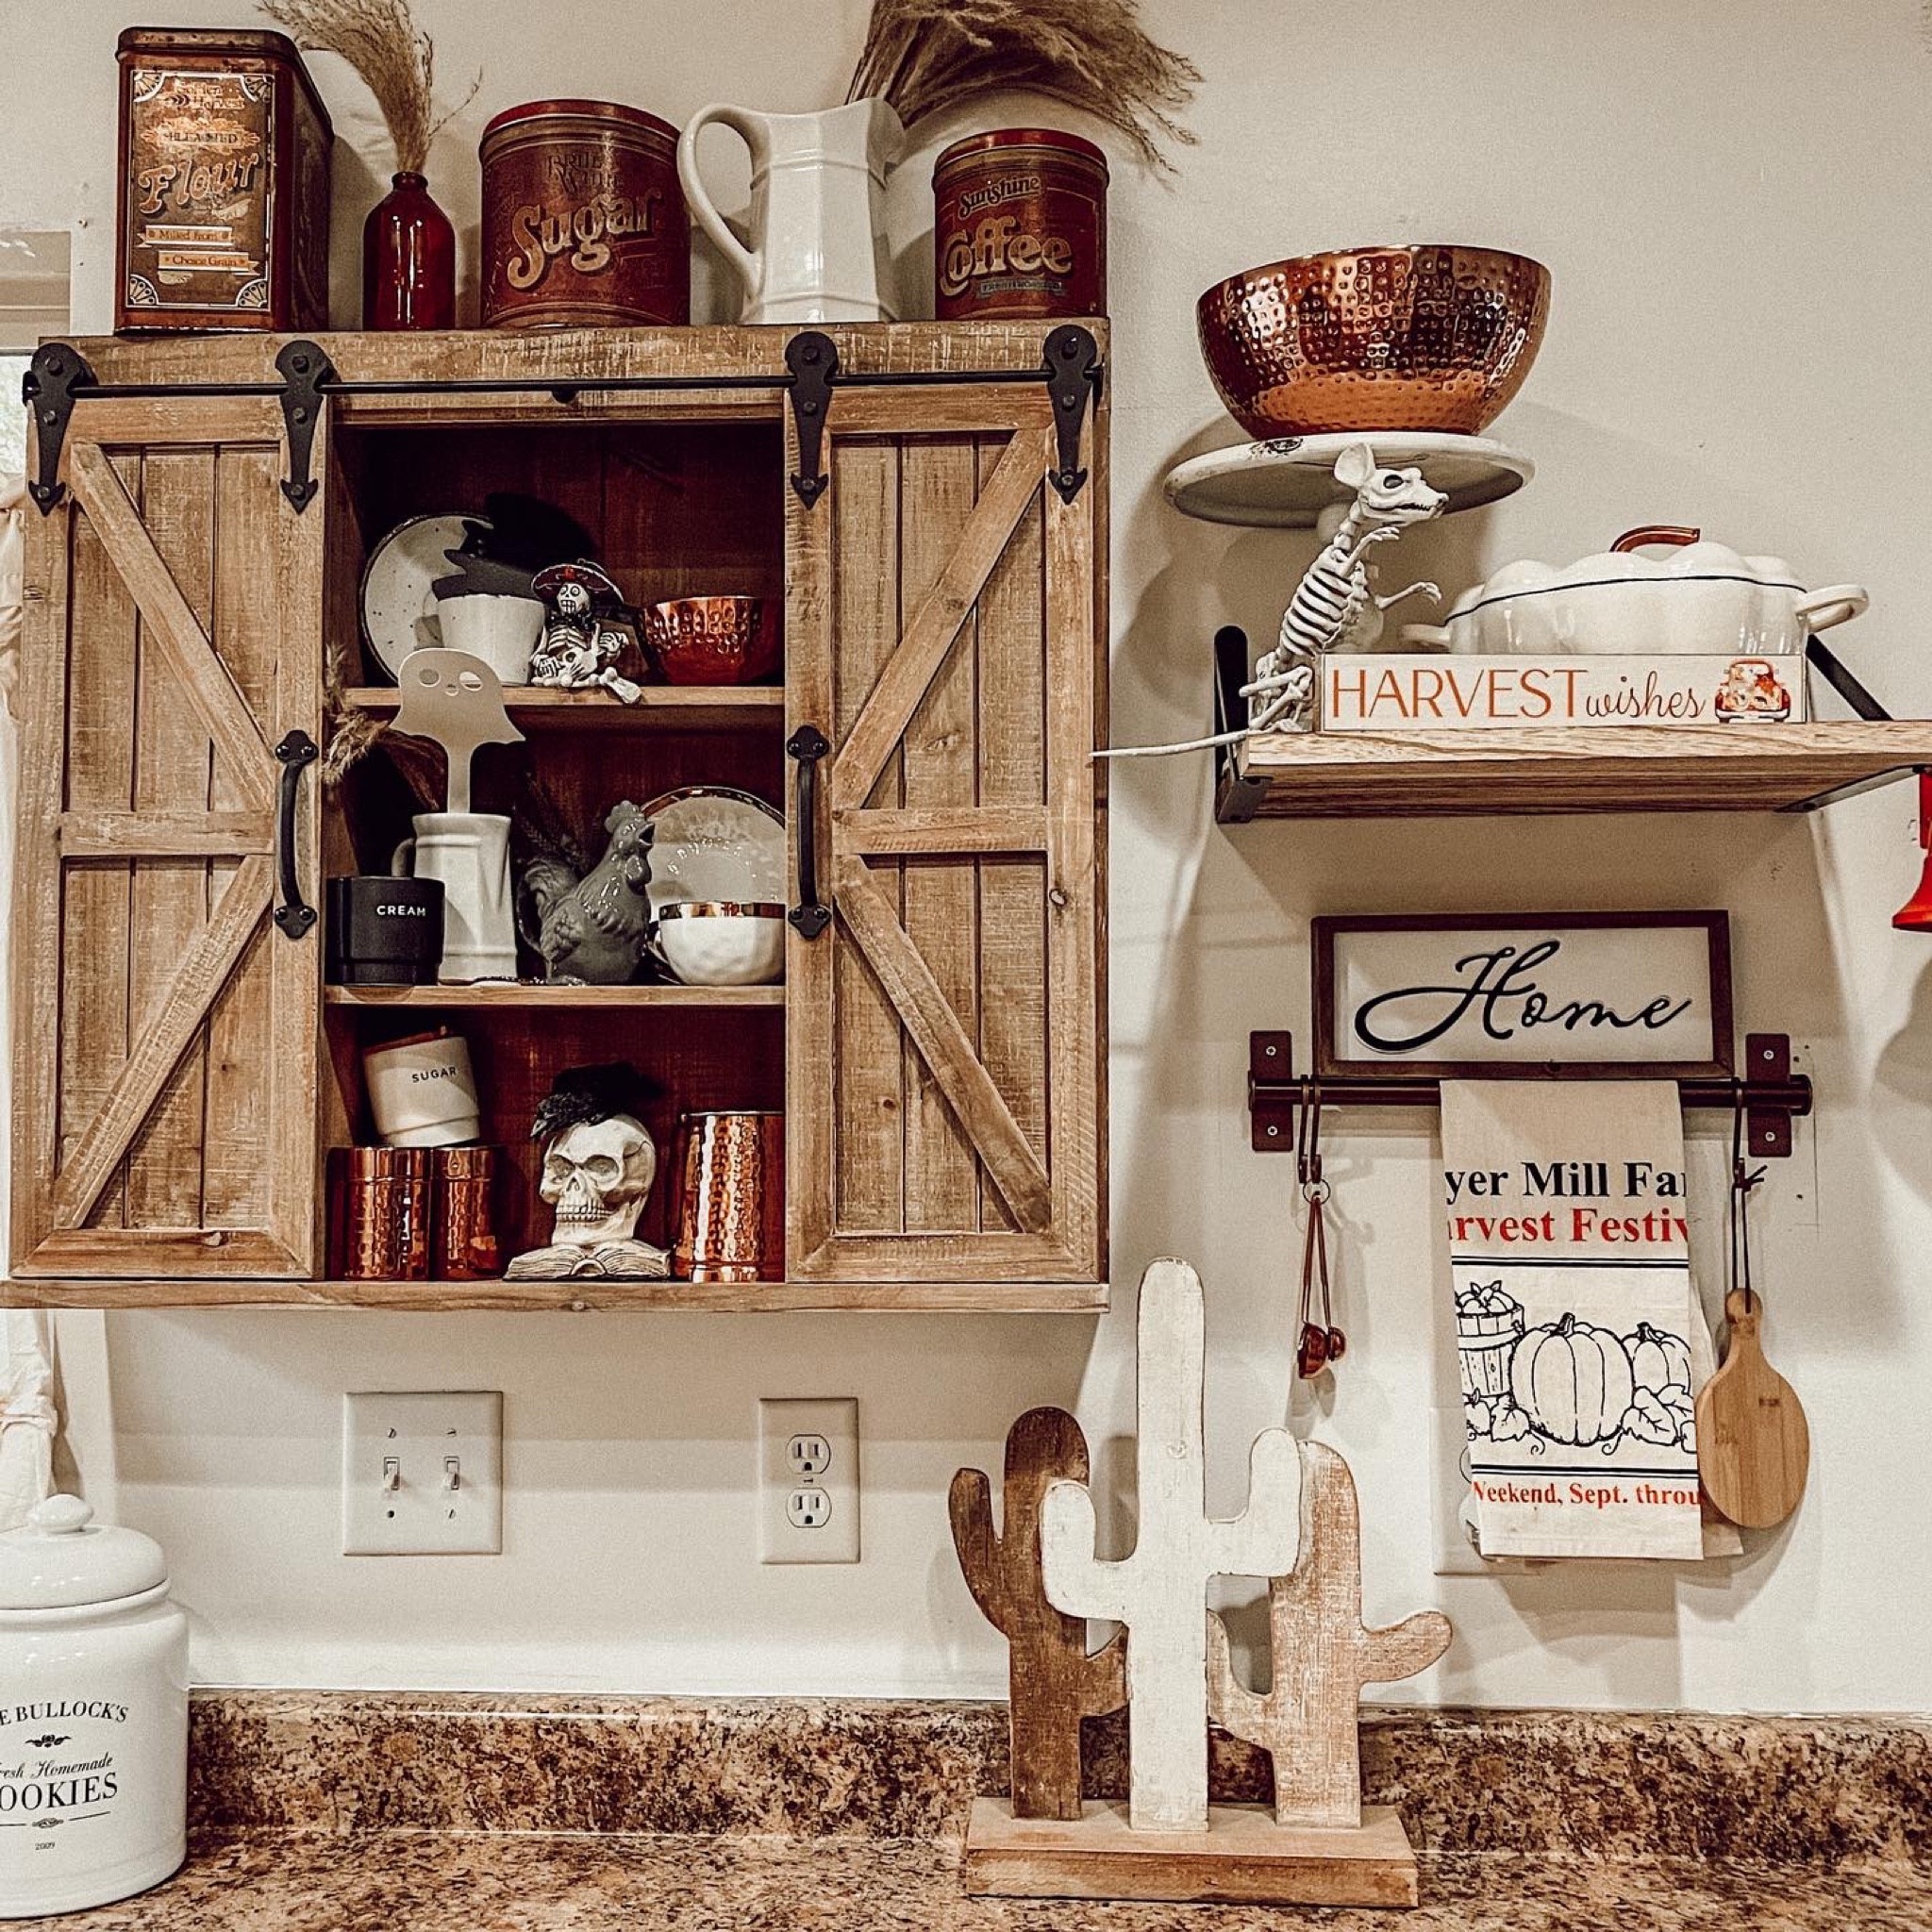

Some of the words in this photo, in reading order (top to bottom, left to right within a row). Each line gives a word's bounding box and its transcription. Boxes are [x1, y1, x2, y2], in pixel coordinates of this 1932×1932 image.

[140, 152, 258, 214] Flour
[958, 176, 1041, 220] Sunshine
[507, 191, 661, 290] Sugar
[941, 216, 1072, 296] Coffee
[1332, 669, 1588, 719] HARVEST
[1587, 671, 1707, 719] wishes
[377, 905, 426, 917] CREAM
[1354, 941, 1692, 1053] Home
[412, 1066, 457, 1083] SUGAR
[1444, 1171, 1509, 1206] yer
[1521, 1161, 1611, 1197] Mill
[1569, 1482, 1628, 1509] Sept.
[16, 1700, 129, 1724] BULLOCK'S
[30, 1752, 113, 1780] Homemade
